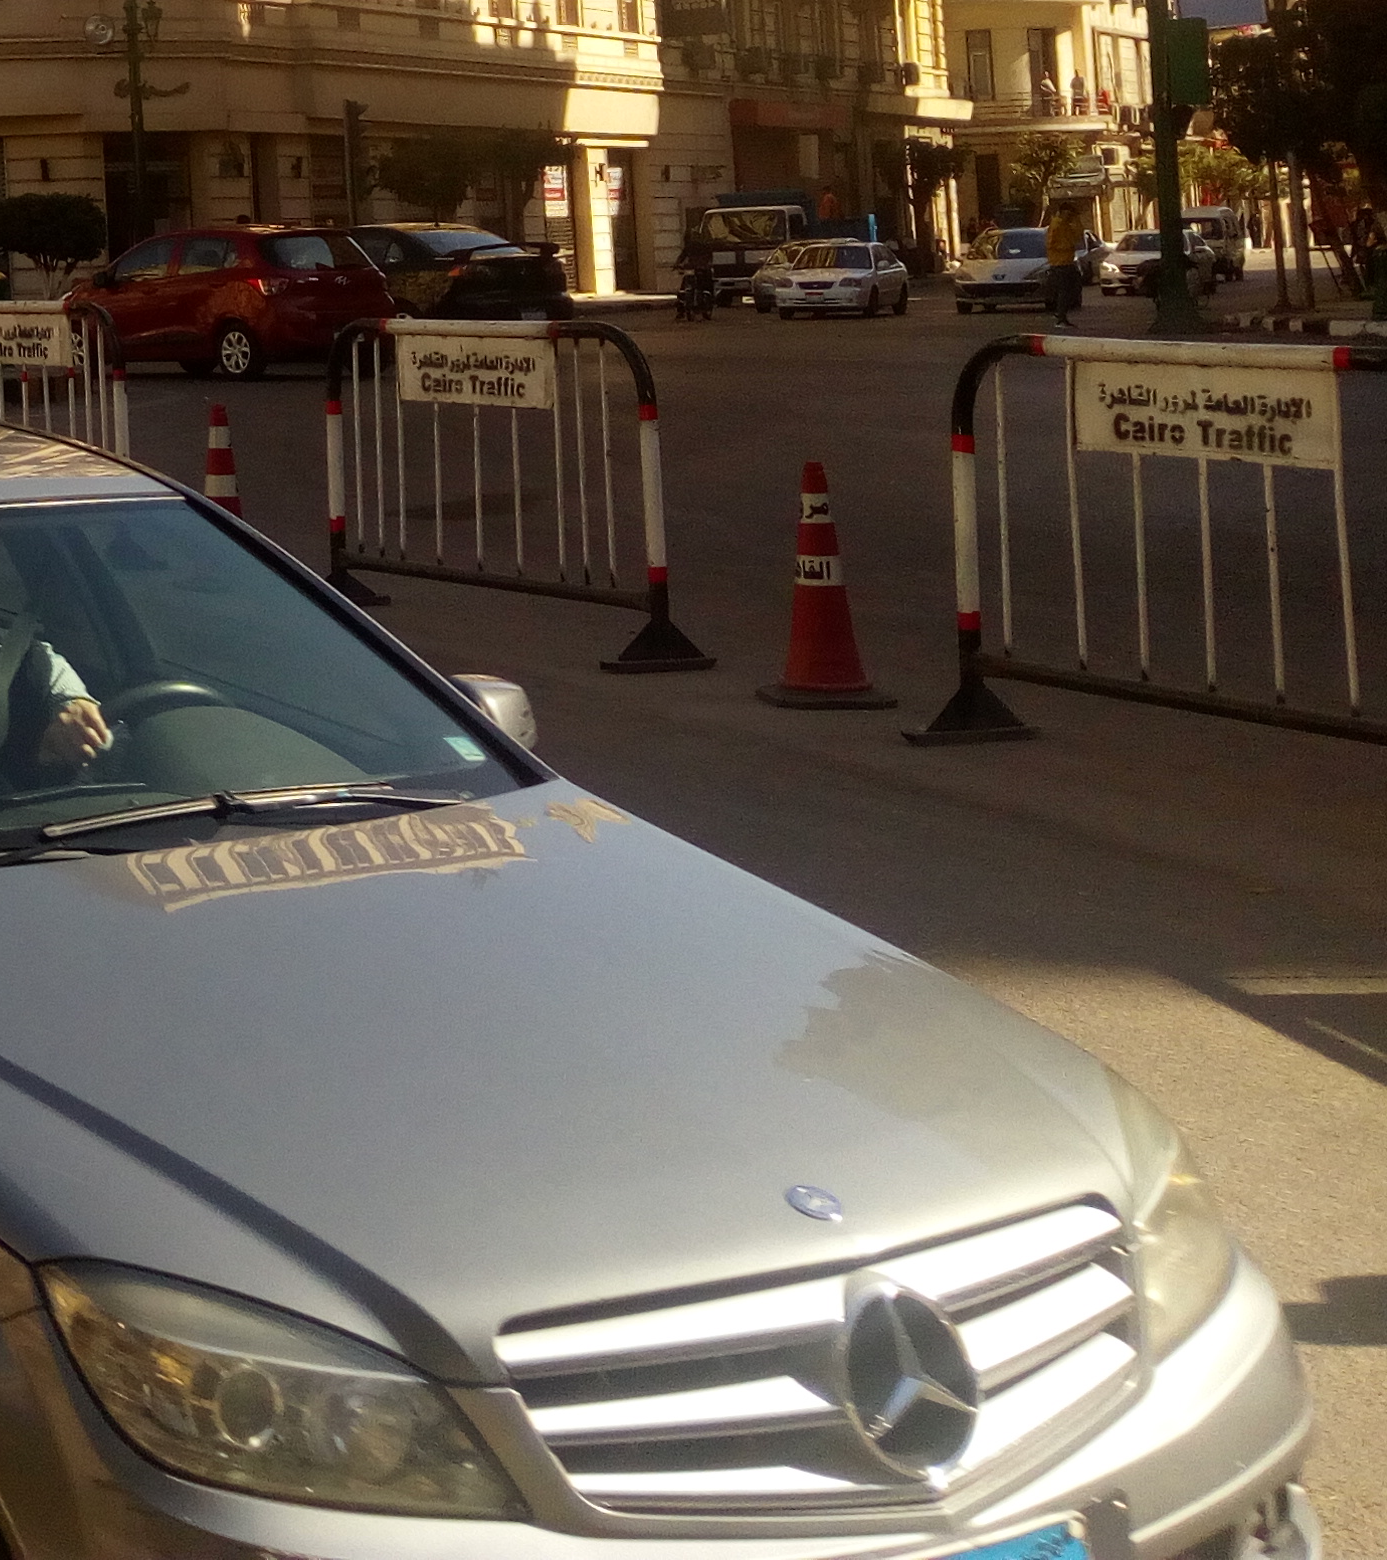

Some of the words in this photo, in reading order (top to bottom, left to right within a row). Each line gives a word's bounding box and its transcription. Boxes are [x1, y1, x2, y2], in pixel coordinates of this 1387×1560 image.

[16, 342, 49, 359] Traffic
[421, 372, 464, 394] Cairo
[469, 375, 526, 398] Traffic
[1097, 381, 1157, 409] القاهرة
[1160, 390, 1199, 414] لمرور
[1113, 412, 1186, 445] Cairo
[1196, 418, 1293, 456] Traffic
